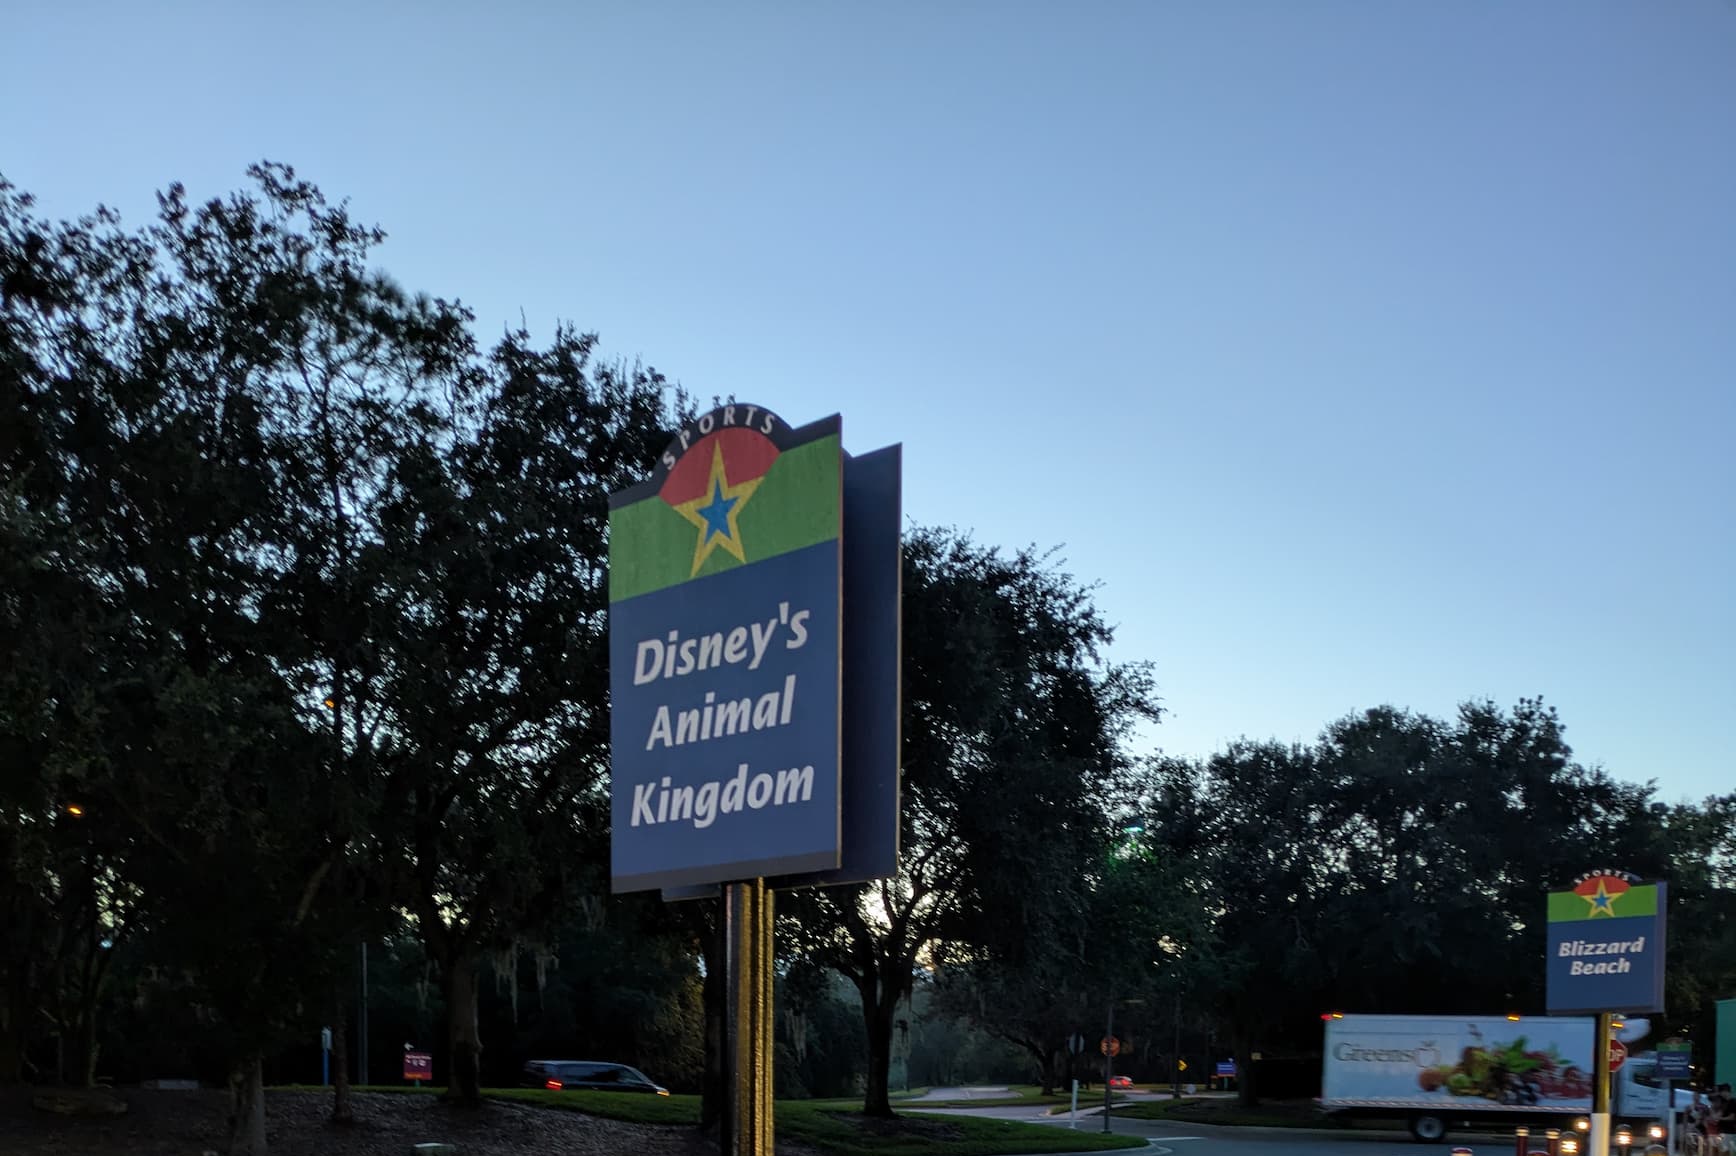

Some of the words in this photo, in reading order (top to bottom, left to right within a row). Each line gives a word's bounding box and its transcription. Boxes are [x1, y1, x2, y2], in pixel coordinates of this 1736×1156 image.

[663, 405, 776, 471] SPORTS
[633, 602, 810, 685] Disney's
[646, 675, 796, 751] Animal
[631, 764, 815, 829] Kingdom
[1558, 936, 1645, 957] Blizzard
[1570, 958, 1631, 975] Beach
